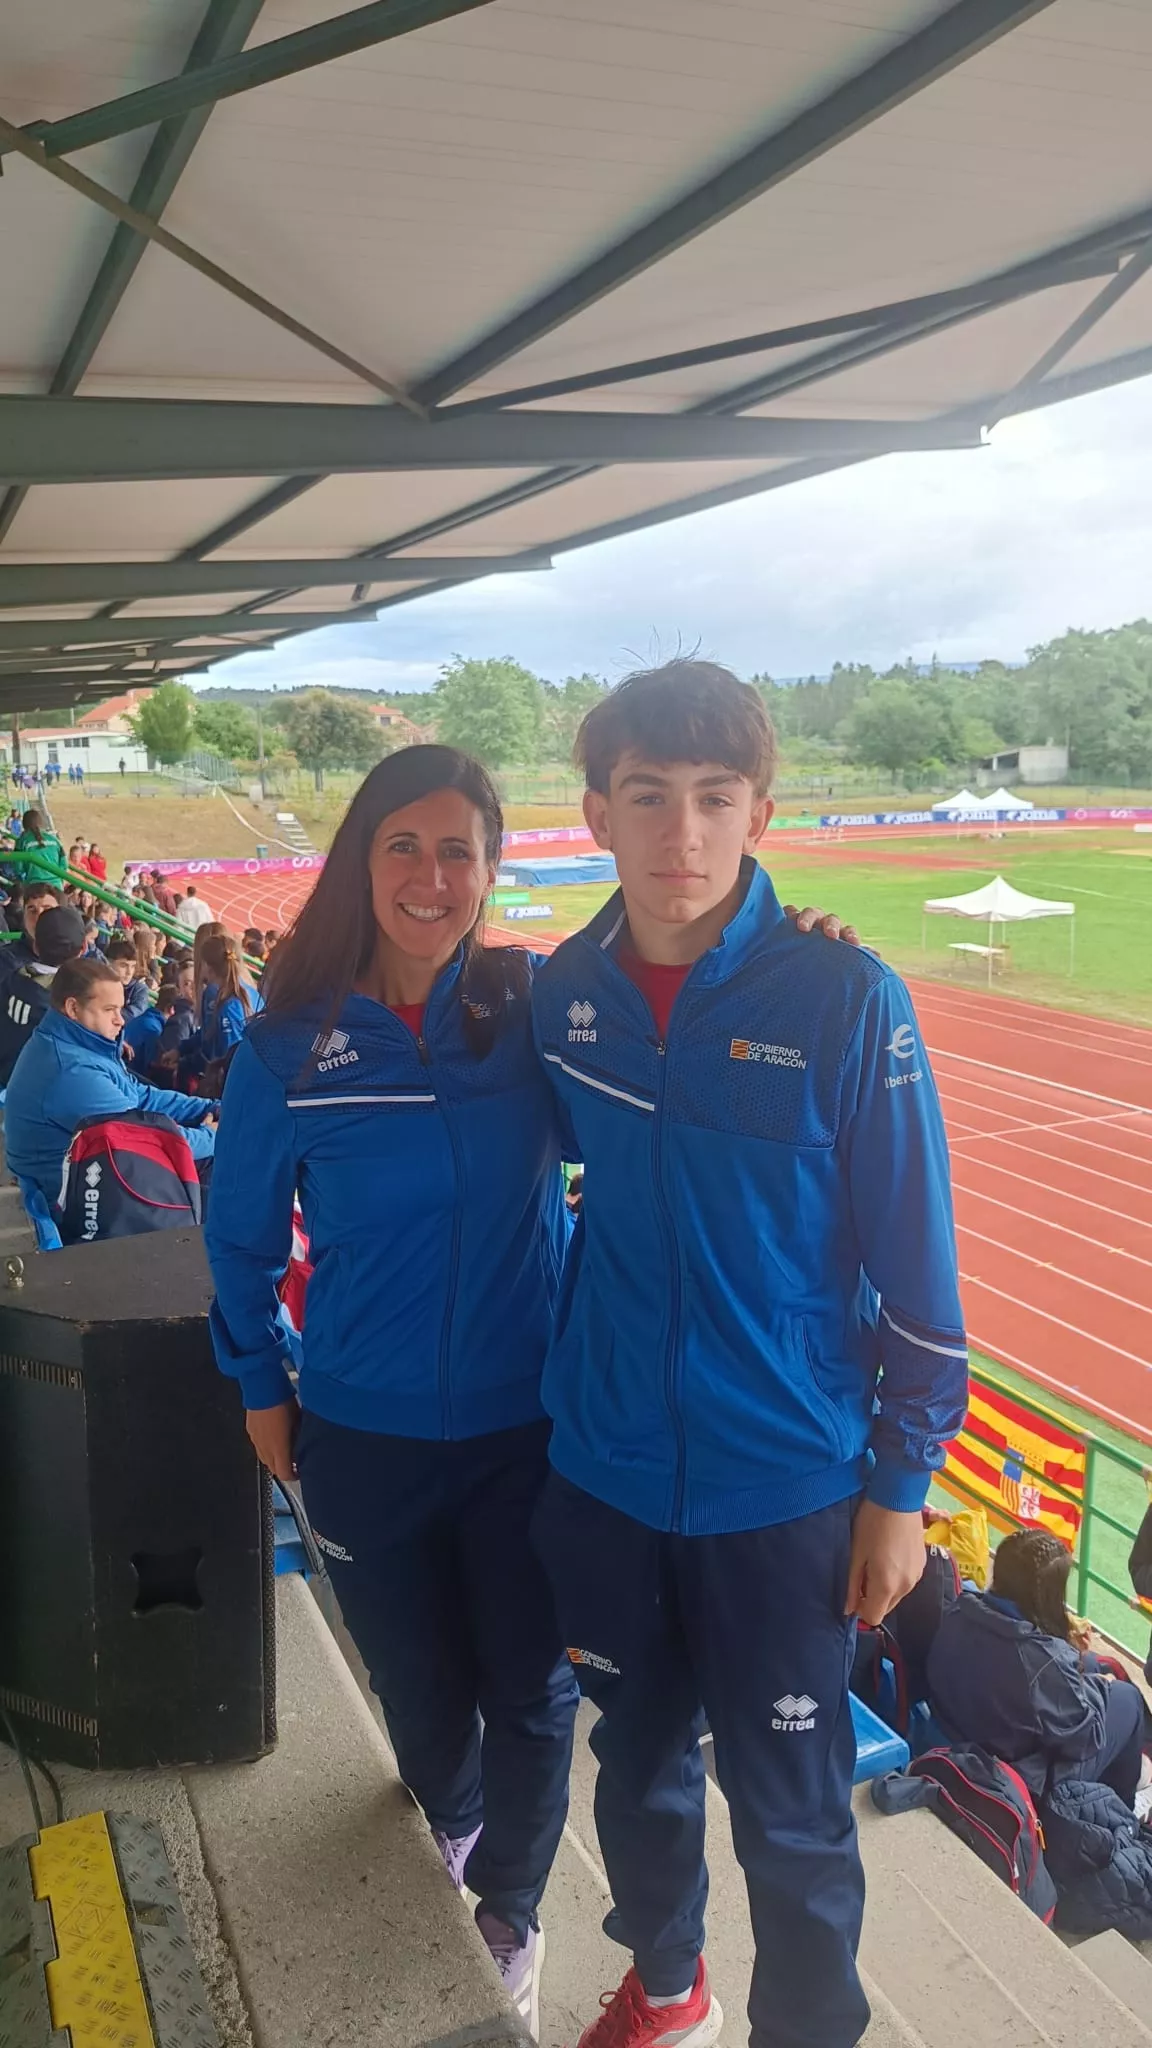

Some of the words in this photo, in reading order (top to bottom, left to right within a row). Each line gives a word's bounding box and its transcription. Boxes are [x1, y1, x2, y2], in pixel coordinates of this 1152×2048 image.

[568, 1029, 597, 1042] errea
[749, 1042, 801, 1058] GOBIERNO
[317, 1049, 360, 1072] errea
[747, 1052, 761, 1061] DE
[763, 1055, 807, 1070] ARAGON
[771, 1717, 816, 1732] errea
